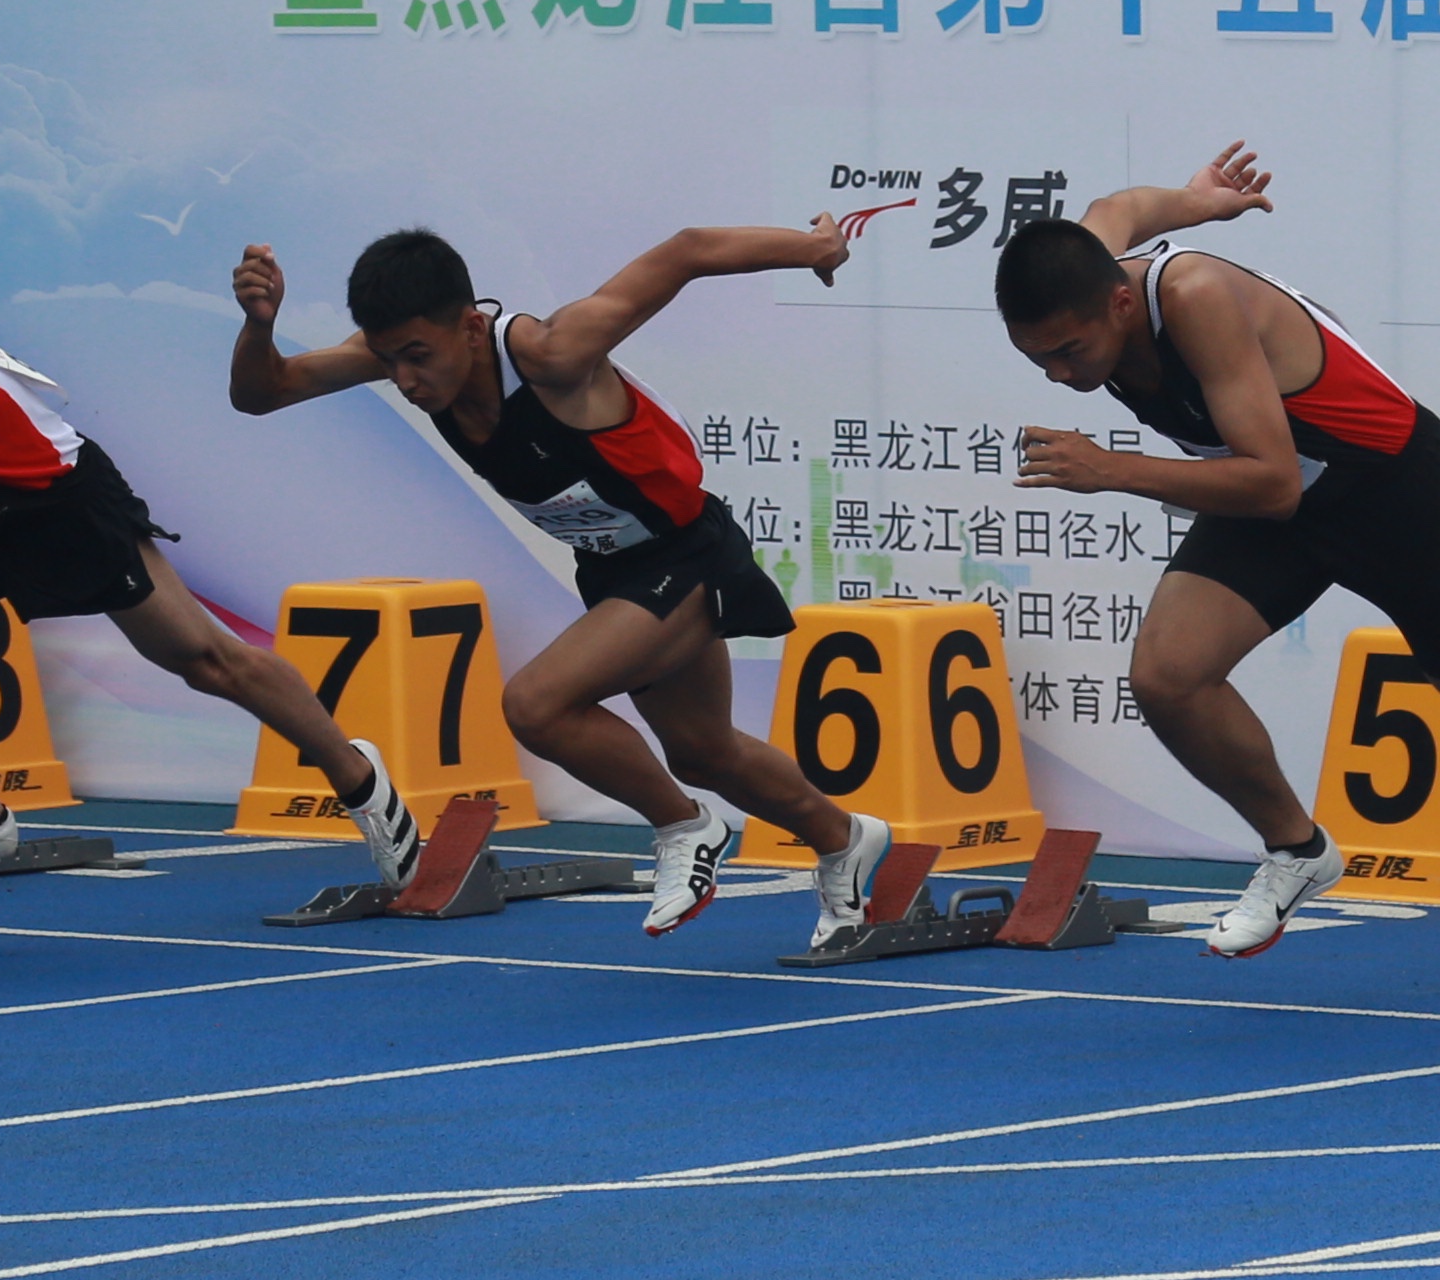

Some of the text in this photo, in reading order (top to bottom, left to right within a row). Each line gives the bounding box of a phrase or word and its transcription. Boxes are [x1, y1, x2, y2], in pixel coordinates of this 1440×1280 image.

[288, 606, 381, 767] 7
[409, 603, 483, 766] 7
[794, 631, 883, 796] 6
[928, 629, 1001, 795] 6
[1009, 671, 1148, 727] 体育局
[1344, 652, 1437, 825] 5
